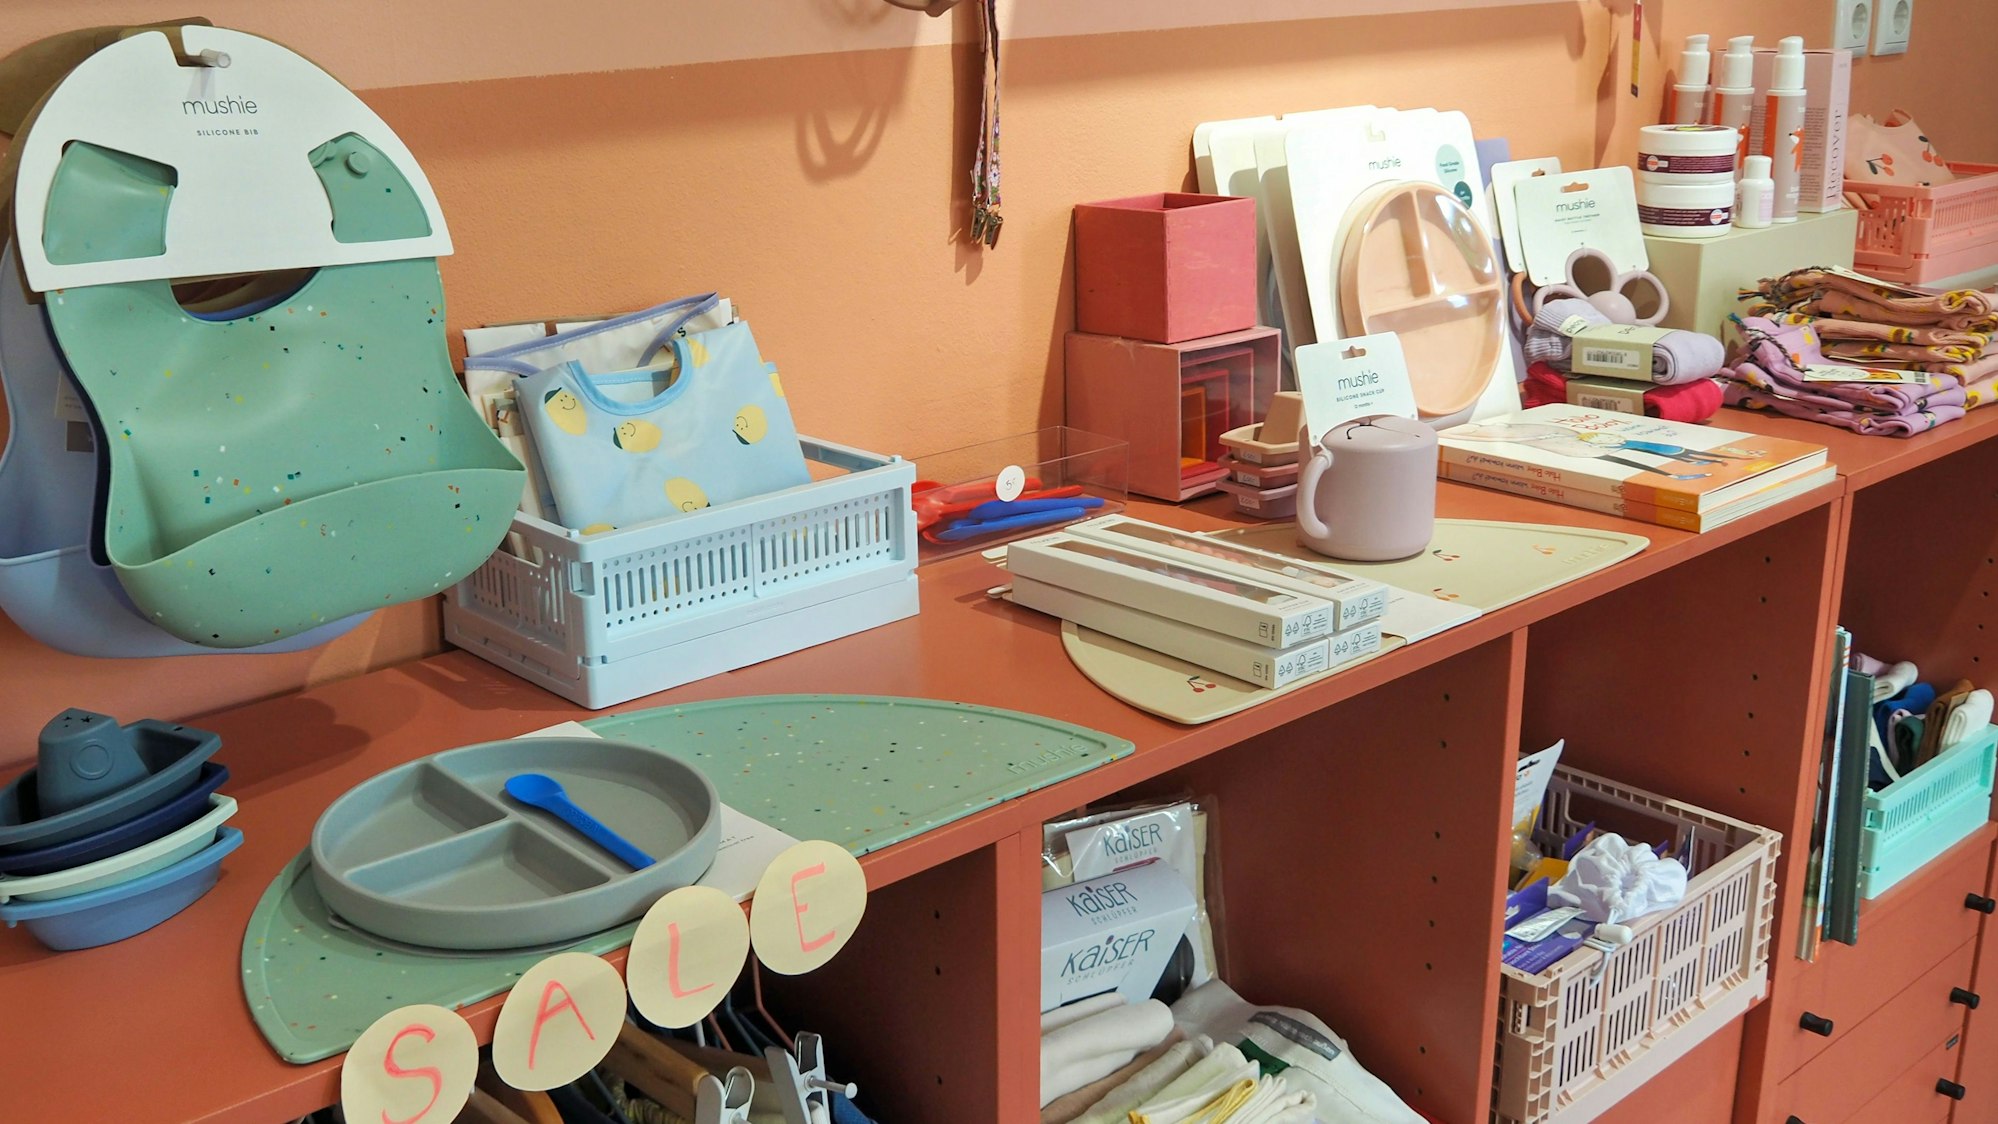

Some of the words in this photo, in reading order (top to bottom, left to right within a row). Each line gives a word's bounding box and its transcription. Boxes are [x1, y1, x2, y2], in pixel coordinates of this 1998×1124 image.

[182, 95, 258, 115] mushie
[1368, 156, 1402, 170] mushie
[1556, 198, 1596, 212] mushie
[1338, 370, 1379, 391] mushie
